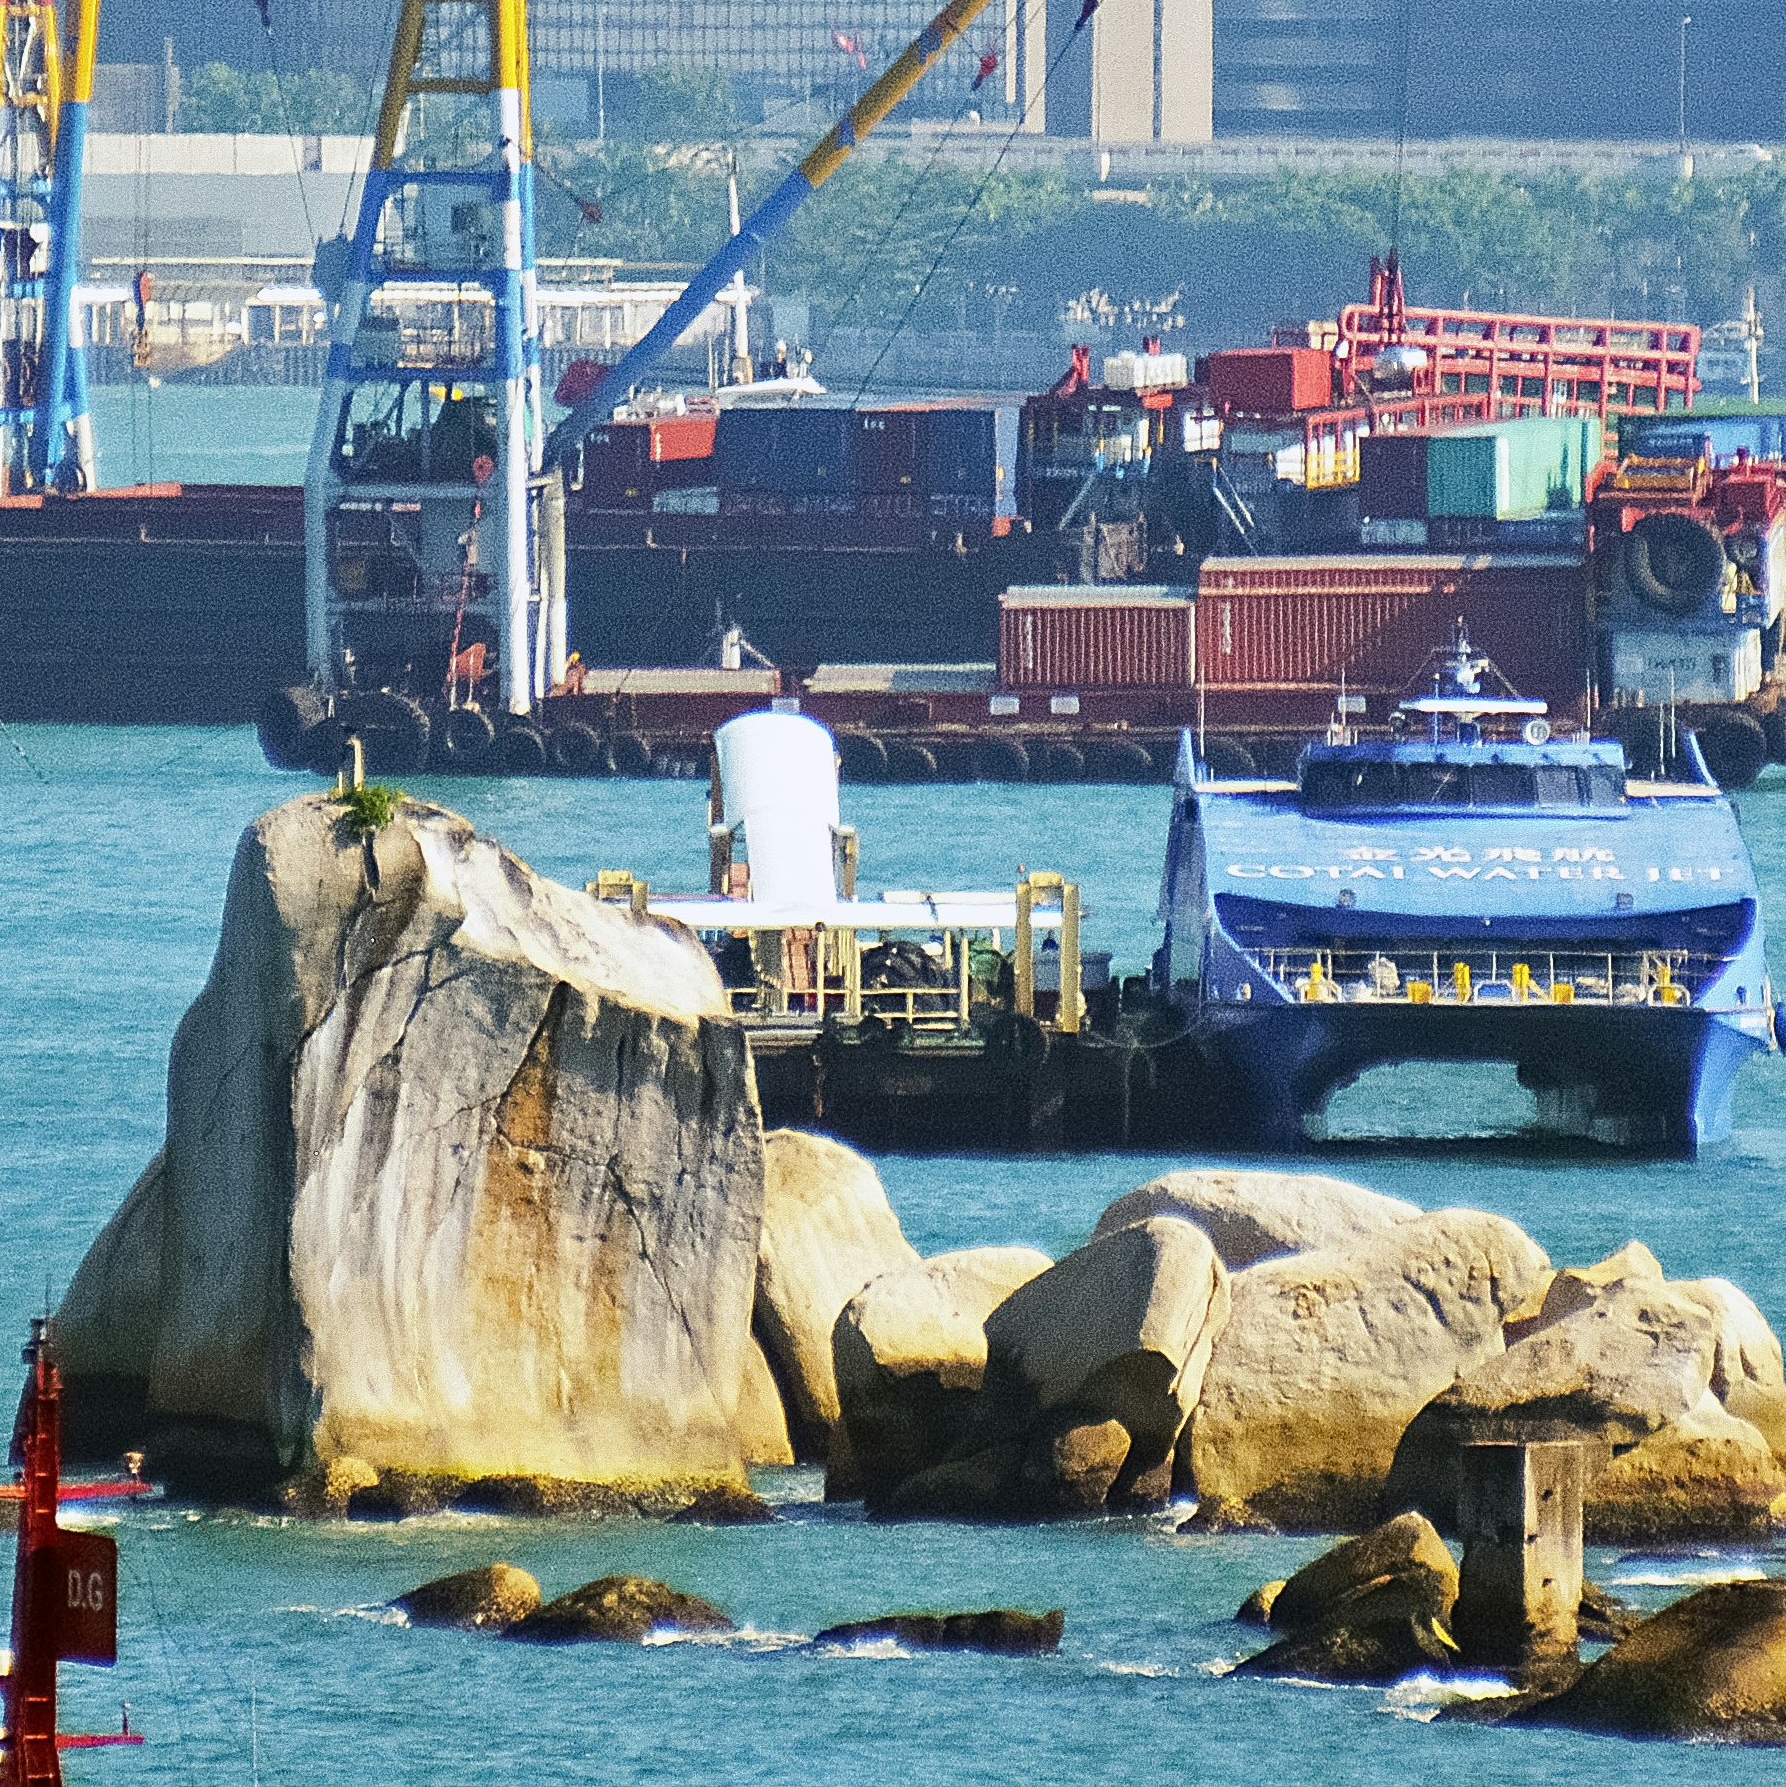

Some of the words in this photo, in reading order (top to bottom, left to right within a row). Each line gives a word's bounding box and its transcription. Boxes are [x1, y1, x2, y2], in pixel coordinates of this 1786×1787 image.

[1226, 863, 1406, 880] COTAI
[1427, 865, 1626, 881] WATER
[1646, 866, 1734, 883] JET
